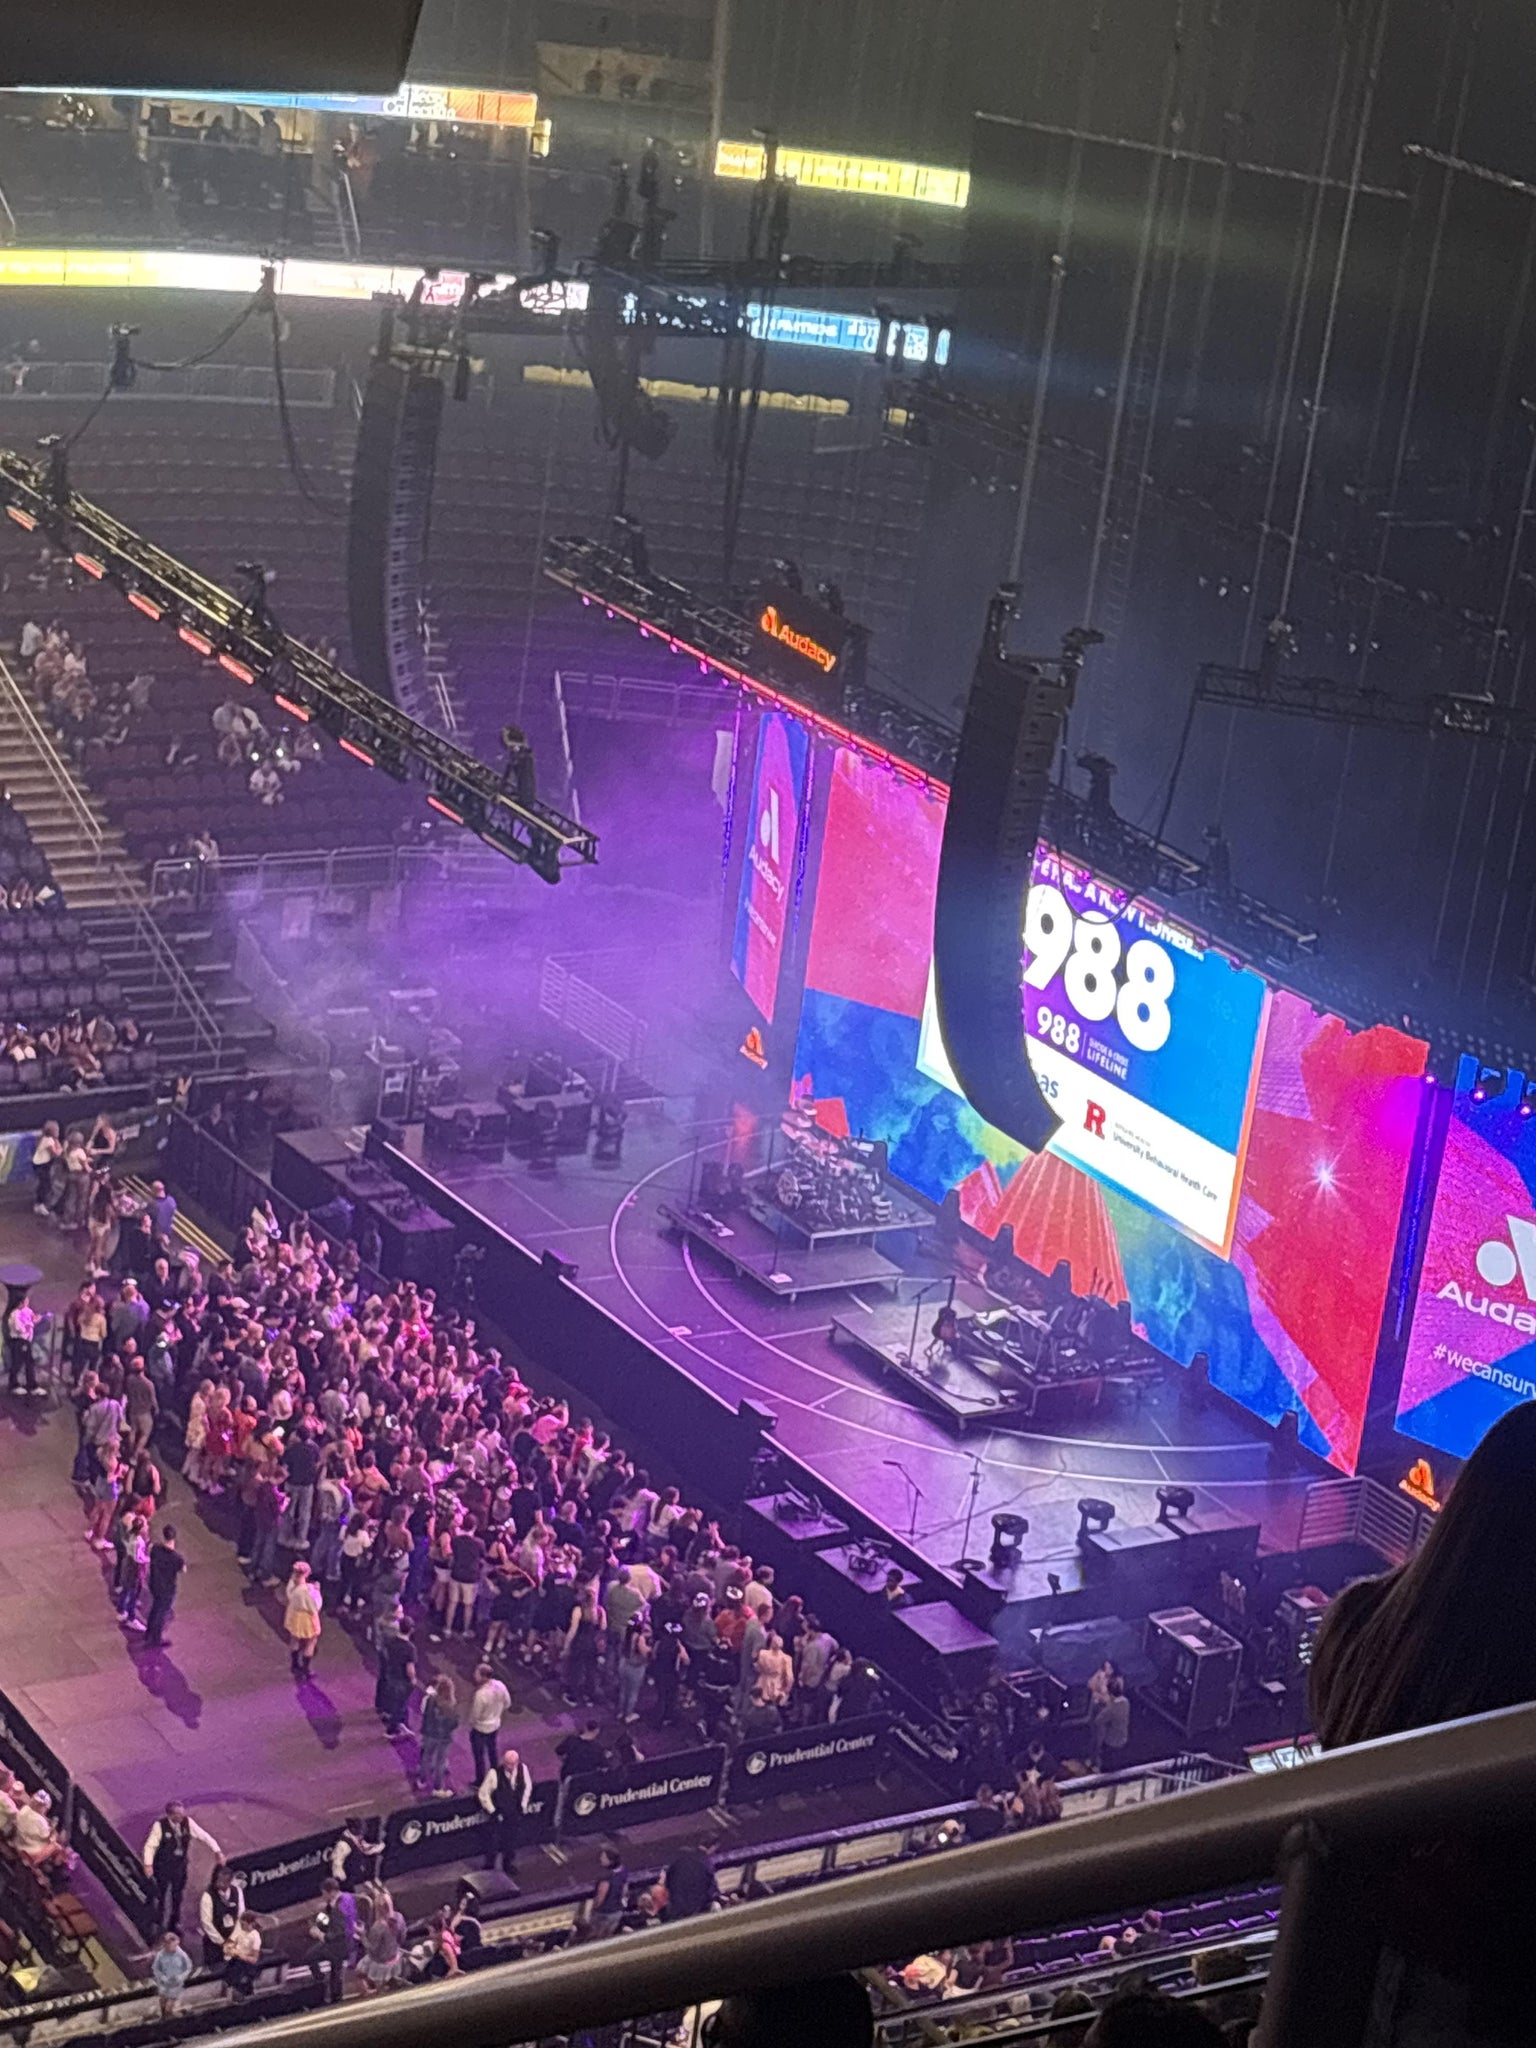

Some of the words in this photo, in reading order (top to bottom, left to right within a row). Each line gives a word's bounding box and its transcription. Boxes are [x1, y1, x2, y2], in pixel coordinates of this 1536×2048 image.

[778, 624, 836, 672] Audacy
[749, 844, 784, 902] Audacy
[1020, 883, 1175, 1052] 988
[1036, 1006, 1080, 1053] 988
[1087, 1047, 1128, 1080] LIFELINE
[1083, 1098, 1106, 1140] R
[1202, 1184, 1218, 1201] Care
[769, 1740, 835, 1768] Prudential
[835, 1733, 877, 1752] Center
[599, 1779, 668, 1809] Prudential
[668, 1773, 713, 1793] Center
[250, 1849, 322, 1887] Prudential
